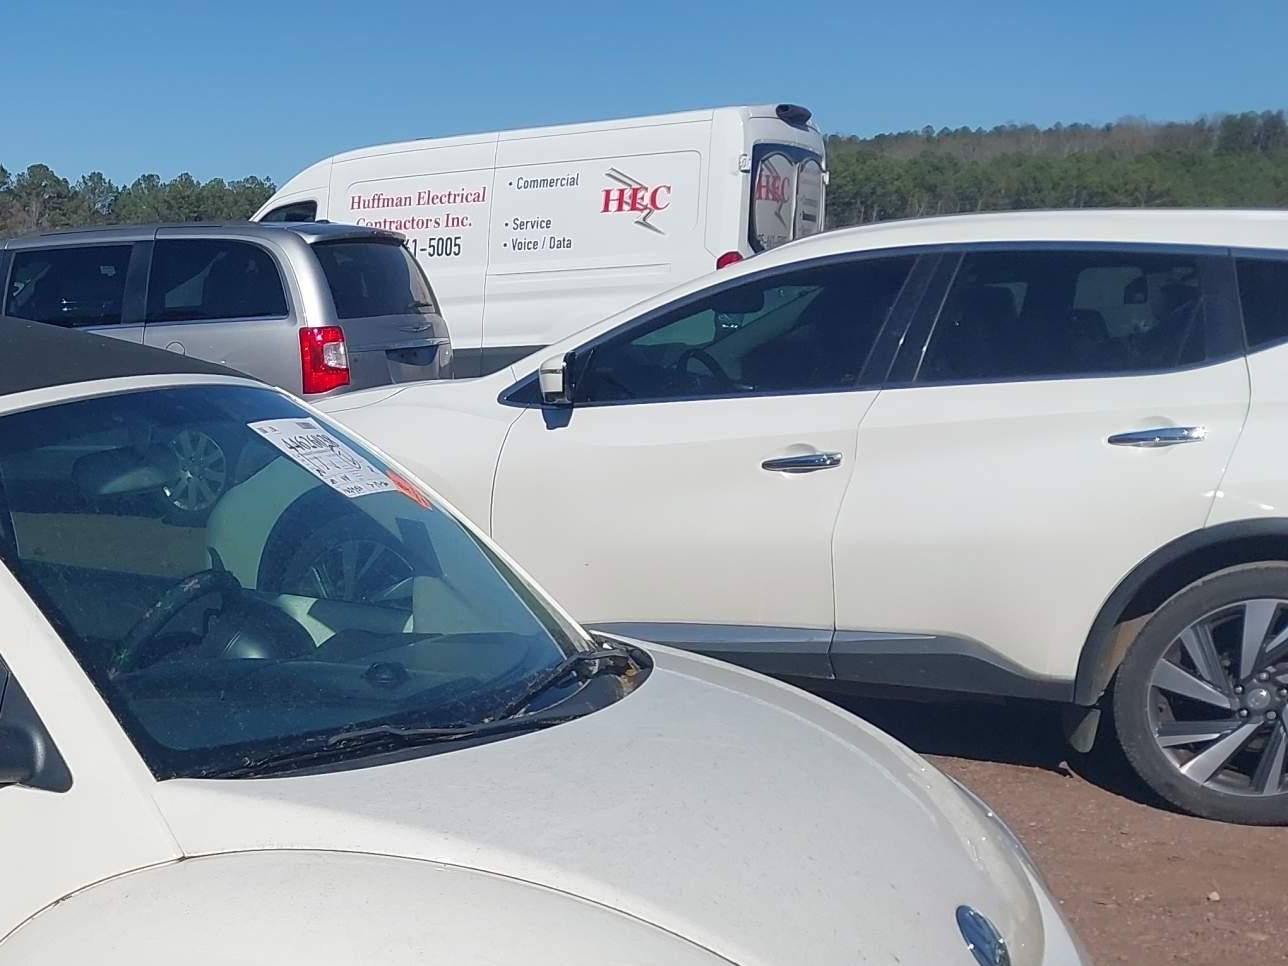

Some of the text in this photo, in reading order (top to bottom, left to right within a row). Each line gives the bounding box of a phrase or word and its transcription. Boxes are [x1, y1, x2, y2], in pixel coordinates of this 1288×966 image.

[516, 173, 580, 190] Commercial
[350, 186, 487, 210] Huffman Electrical
[600, 185, 672, 213] HEC
[444, 213, 472, 228] Inc.
[512, 217, 552, 230] Service
[511, 238, 539, 251] Voice
[549, 237, 572, 249] Data
